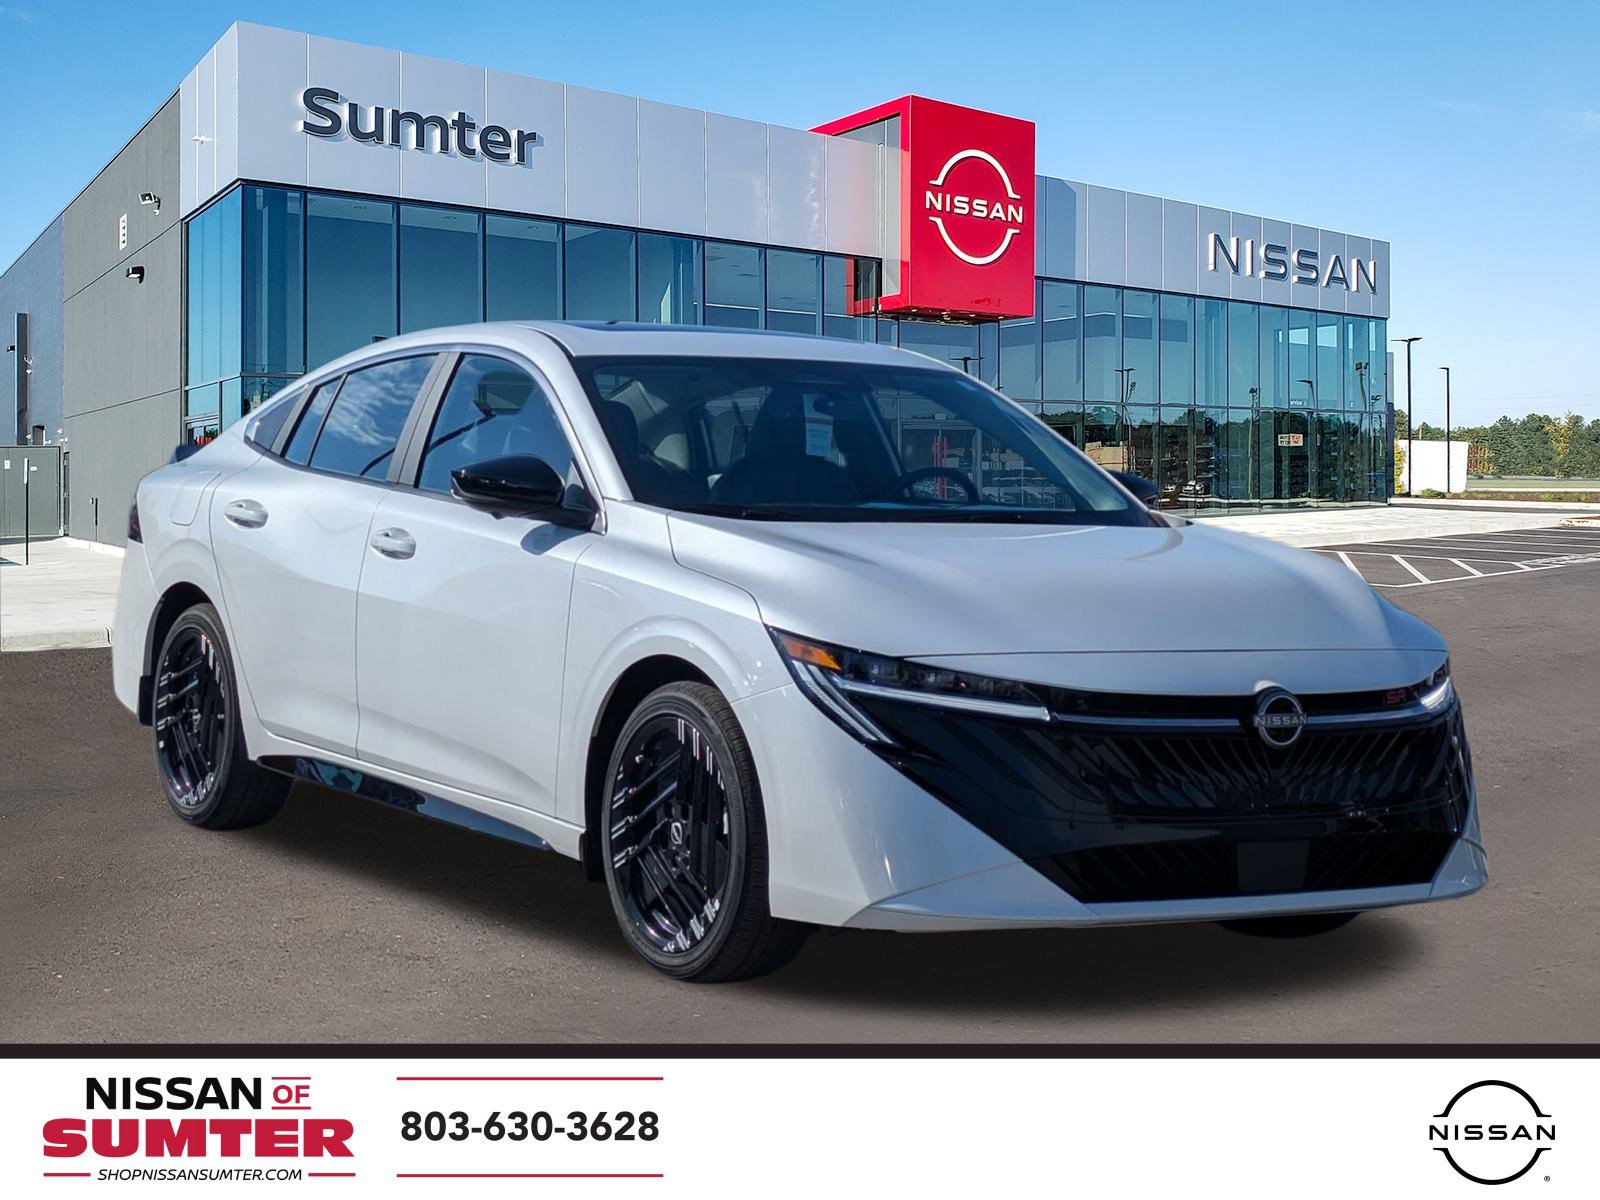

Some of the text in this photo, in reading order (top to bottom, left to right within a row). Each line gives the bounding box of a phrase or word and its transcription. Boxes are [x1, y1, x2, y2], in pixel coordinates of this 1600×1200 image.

[300, 86, 540, 166] Sumter
[925, 190, 1024, 224] NISSAN
[1207, 231, 1377, 294] NISSAN
[1253, 713, 1307, 728] NISSAN
